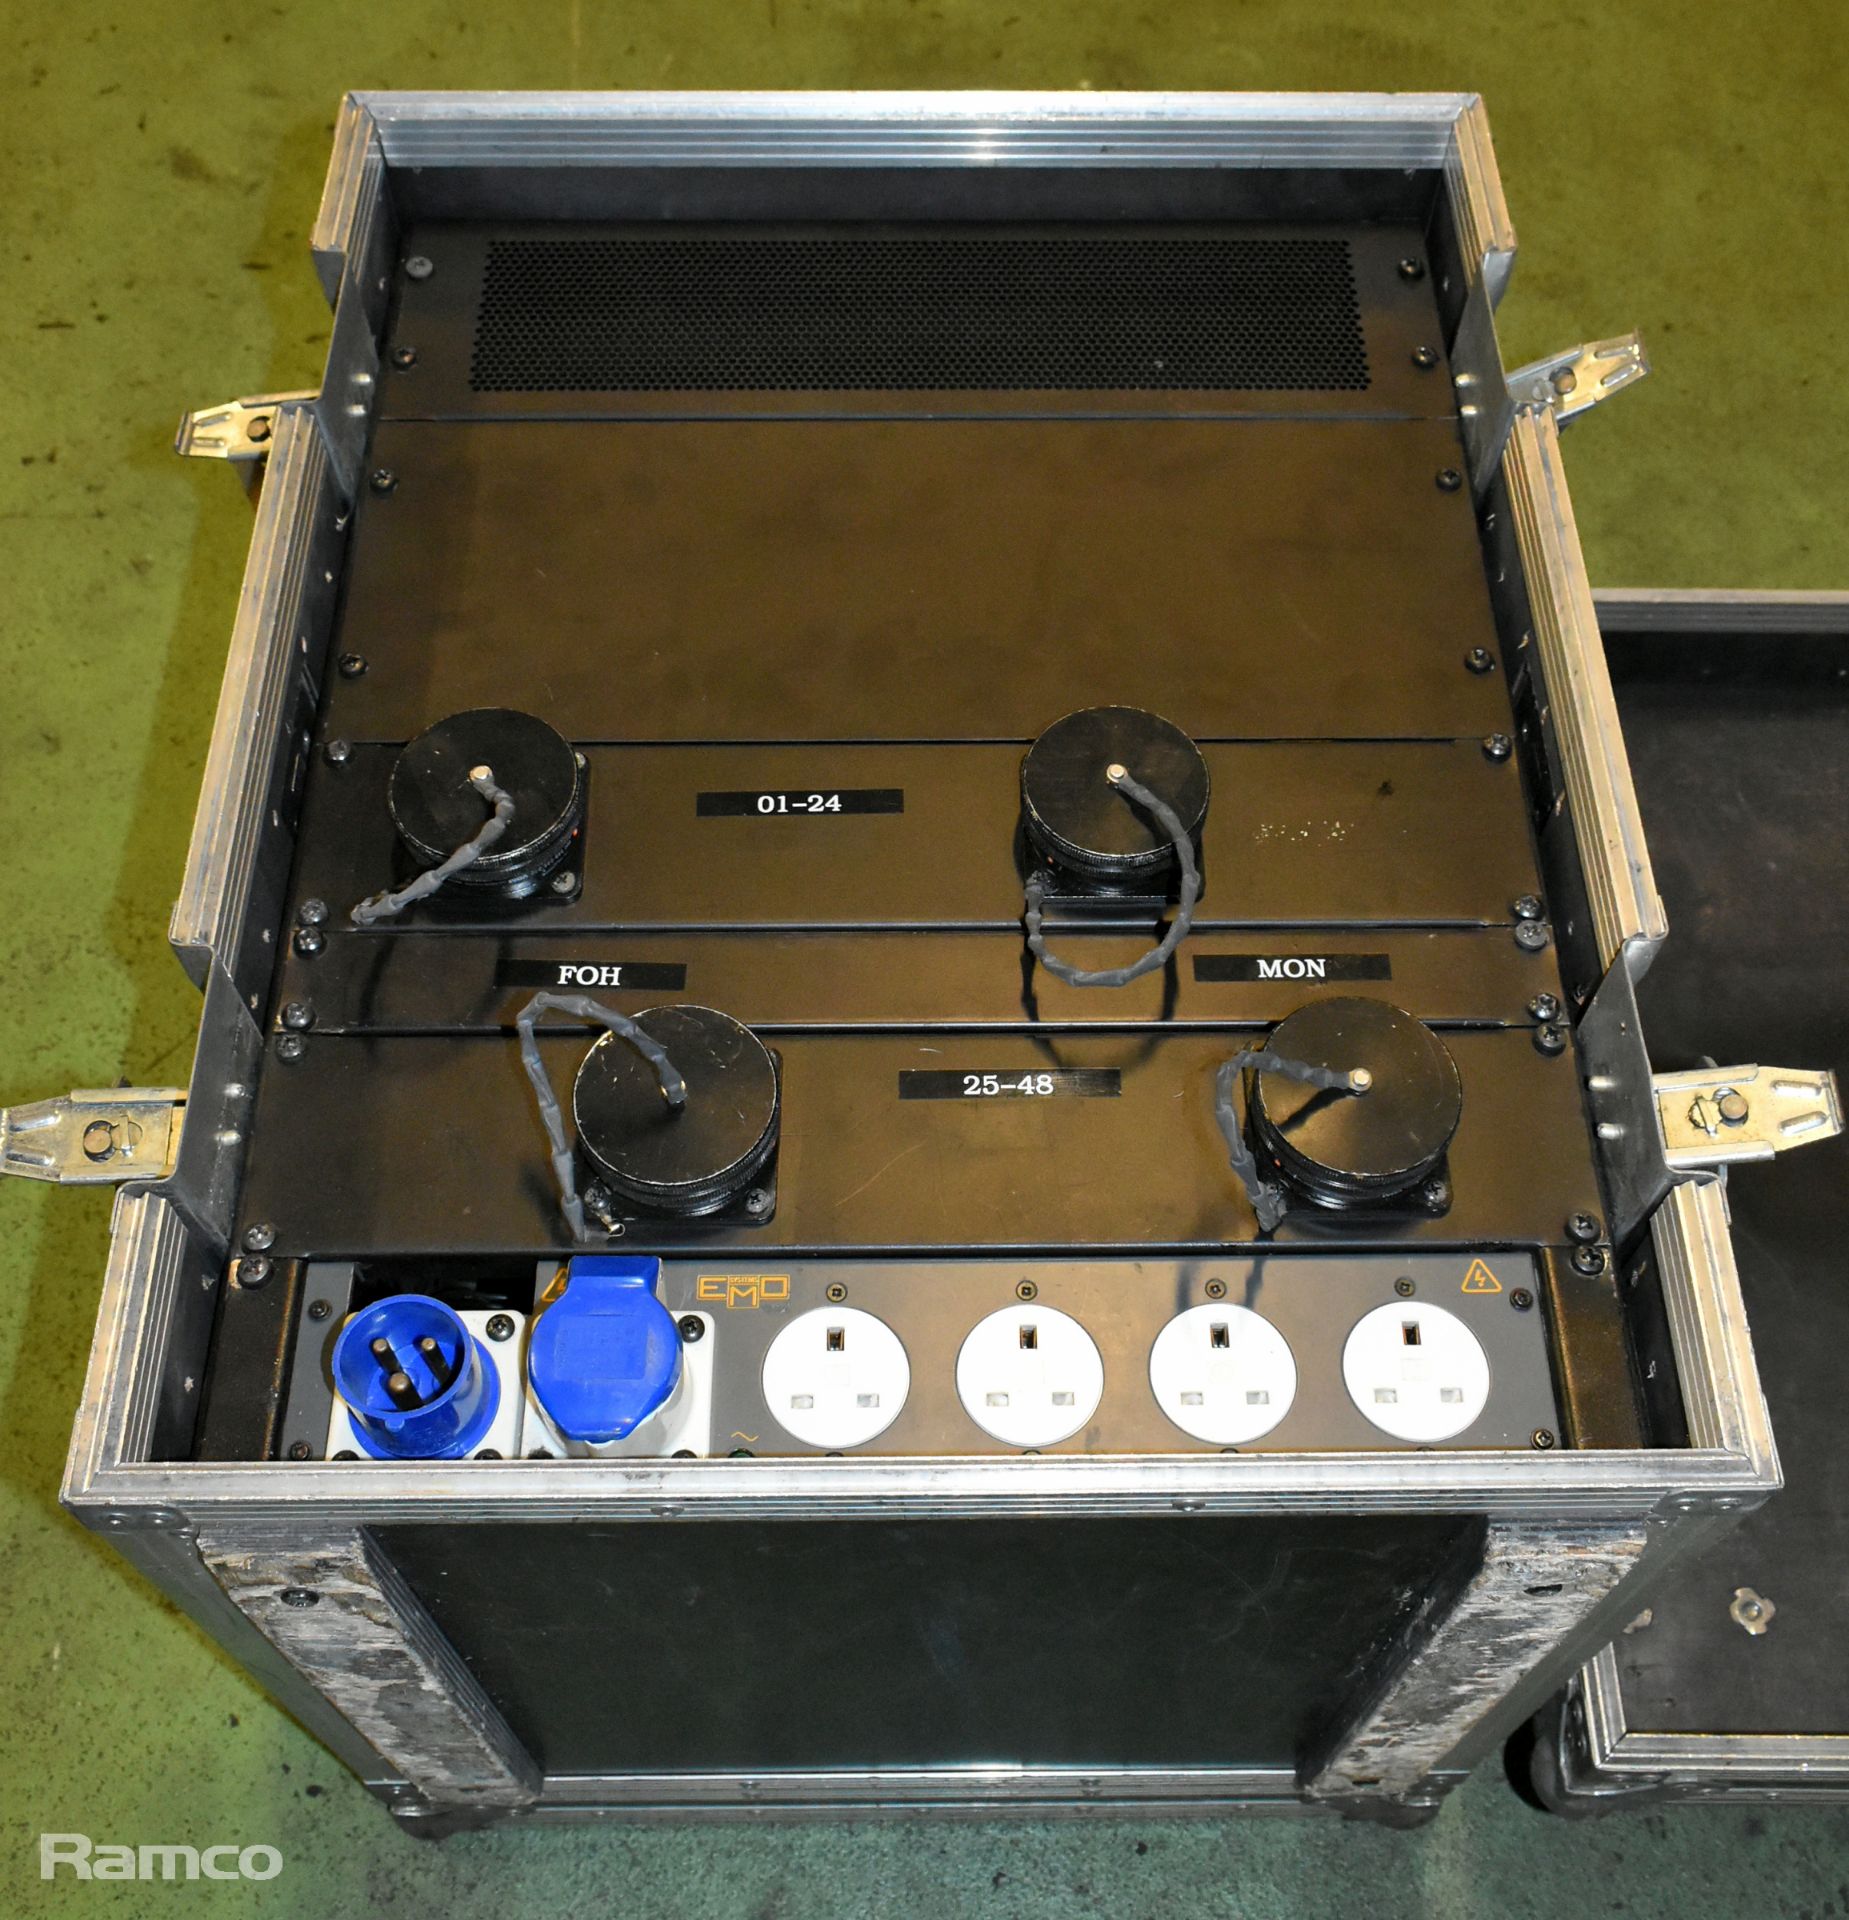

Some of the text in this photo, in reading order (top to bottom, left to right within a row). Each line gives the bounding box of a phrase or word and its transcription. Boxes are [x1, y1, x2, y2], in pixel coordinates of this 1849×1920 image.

[757, 794, 842, 813] 01-24
[557, 965, 622, 986] FOH
[1256, 958, 1327, 978] MON
[963, 1074, 1054, 1096] 25-48
[699, 1276, 788, 1306] EMO
